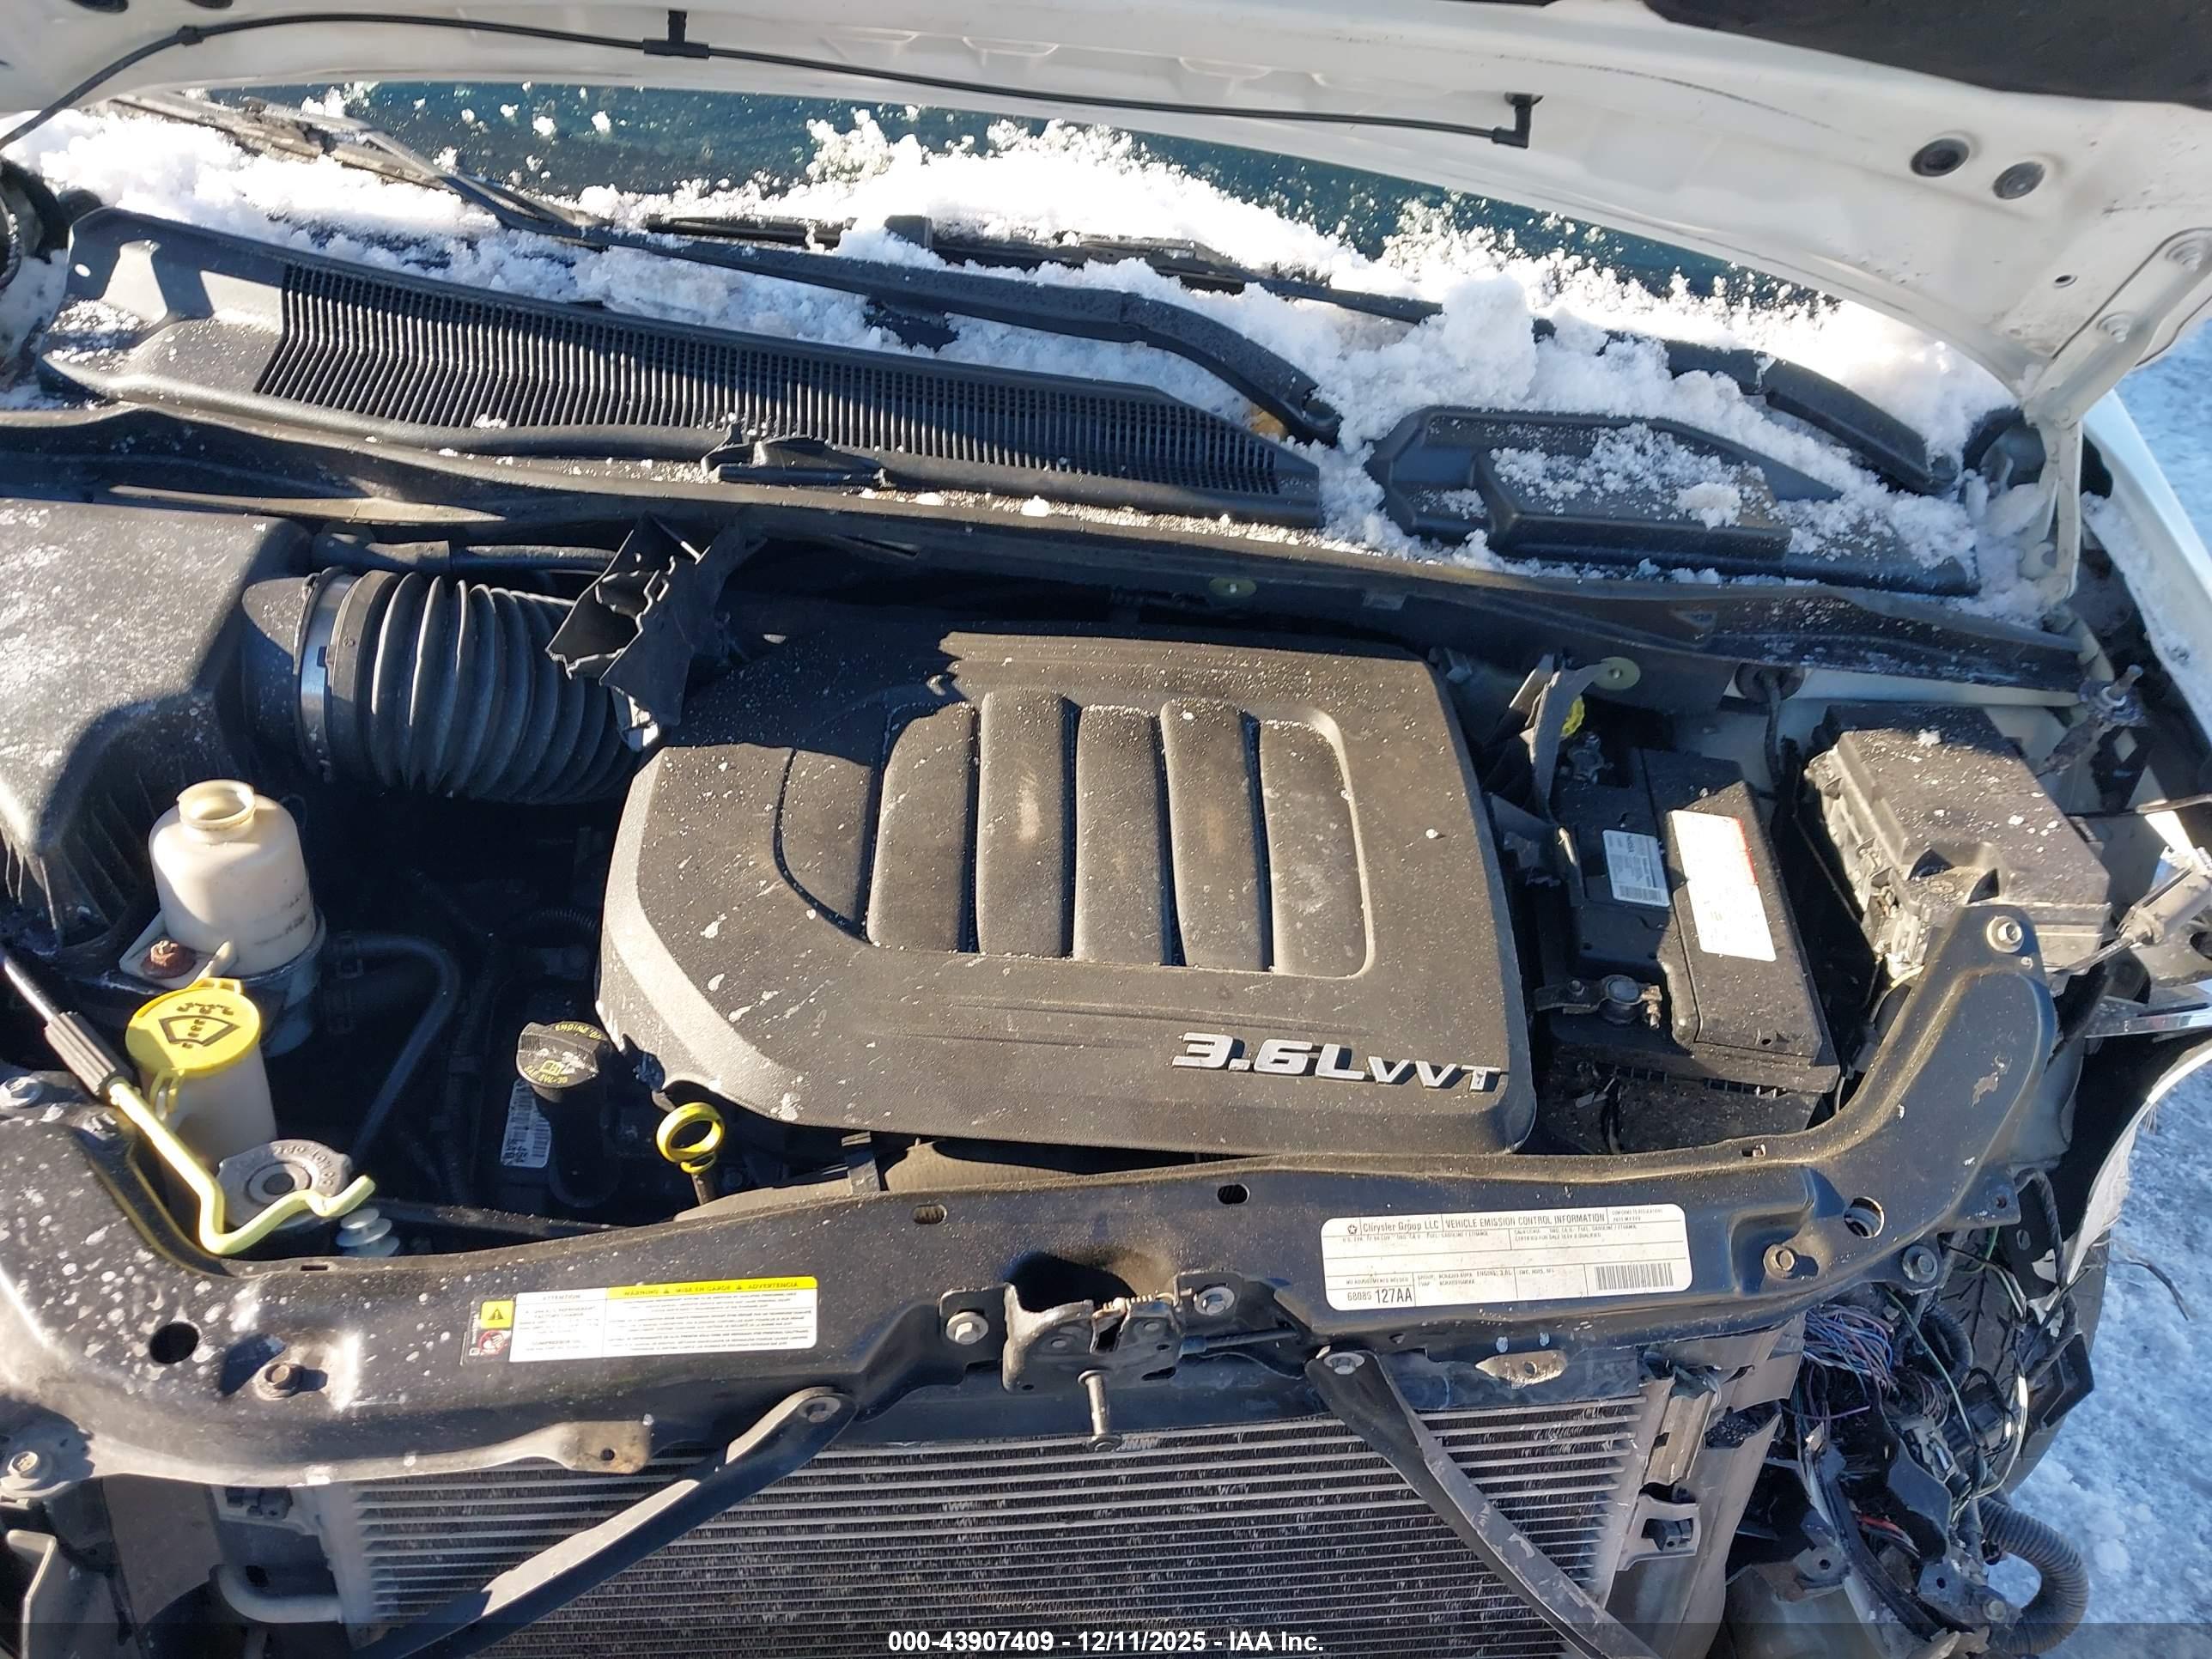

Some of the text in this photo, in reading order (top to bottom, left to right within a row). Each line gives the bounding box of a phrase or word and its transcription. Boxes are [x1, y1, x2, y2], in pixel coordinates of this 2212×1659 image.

[1171, 1032, 1502, 1093] 3.6L VVT
[1363, 1219, 1439, 1234] Chrysler Group LLC
[1445, 1218, 1478, 1229] VEHICLE
[1480, 1216, 1516, 1227] EMISSION
[1518, 1214, 1553, 1226] CONTROL
[1554, 1212, 1606, 1225] INFORMATION
[1375, 1287, 1413, 1304] 127AA
